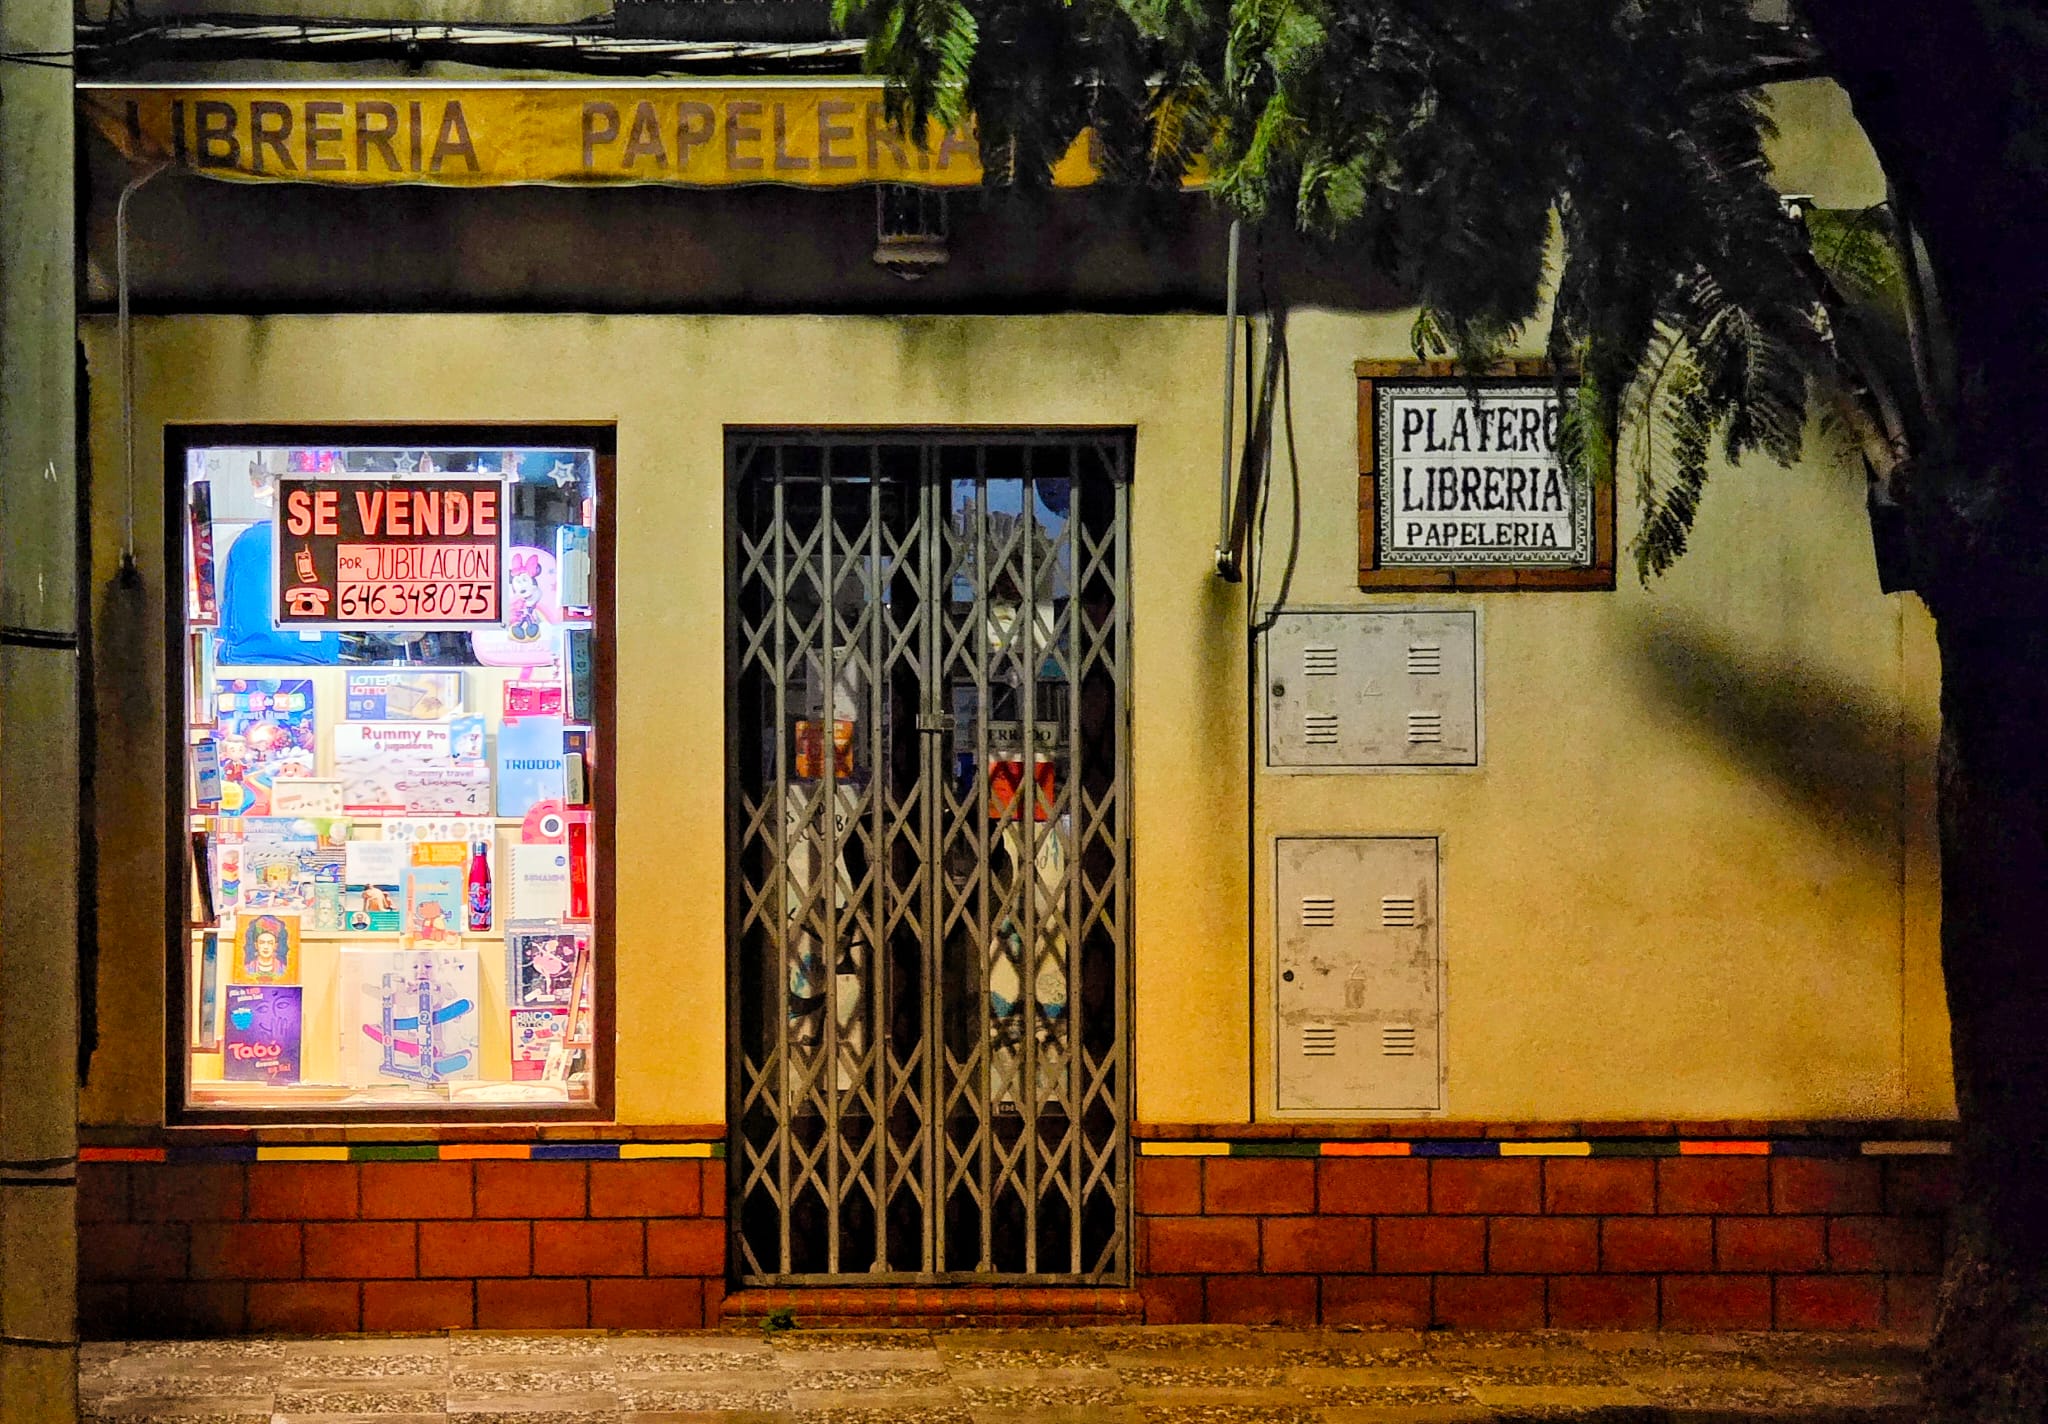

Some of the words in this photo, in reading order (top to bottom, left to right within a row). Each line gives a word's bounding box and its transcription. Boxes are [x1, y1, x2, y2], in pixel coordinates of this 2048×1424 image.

[582, 101, 978, 170] PAPELERA
[1401, 466, 1564, 512] LIBRERIA
[287, 490, 339, 536] SE
[355, 490, 497, 536] VENDE
[1406, 522, 1558, 547] PAPELERIA
[339, 556, 362, 570] POR
[366, 546, 489, 580] JUBILACIÓN
[341, 583, 492, 616] 646348075
[361, 727, 421, 743] Rummy
[427, 730, 447, 740] Pro
